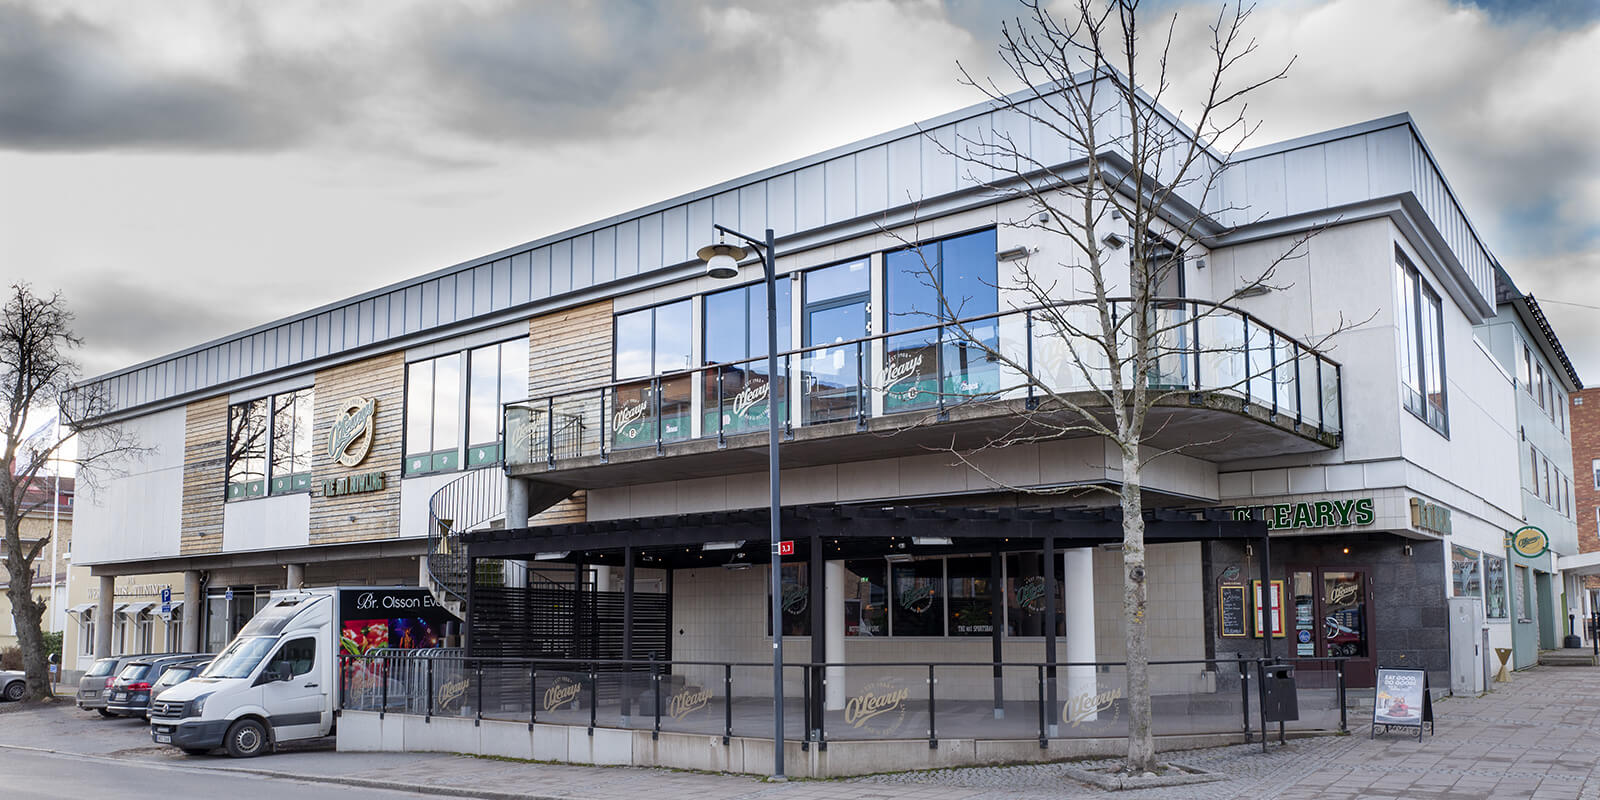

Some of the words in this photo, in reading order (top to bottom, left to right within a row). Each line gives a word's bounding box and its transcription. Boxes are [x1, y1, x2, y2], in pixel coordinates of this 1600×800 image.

[613, 400, 647, 435] O'Learys
[733, 382, 770, 418] O'Leary
[328, 398, 374, 462] O'Learys
[357, 592, 379, 609] Br.
[382, 596, 420, 609] Olsson
[438, 678, 470, 709] O'Learys
[544, 682, 581, 713] O'Learys
[670, 687, 713, 722] O'Learys
[845, 687, 909, 729] O'Learys
[1062, 687, 1121, 729] O'Learys
